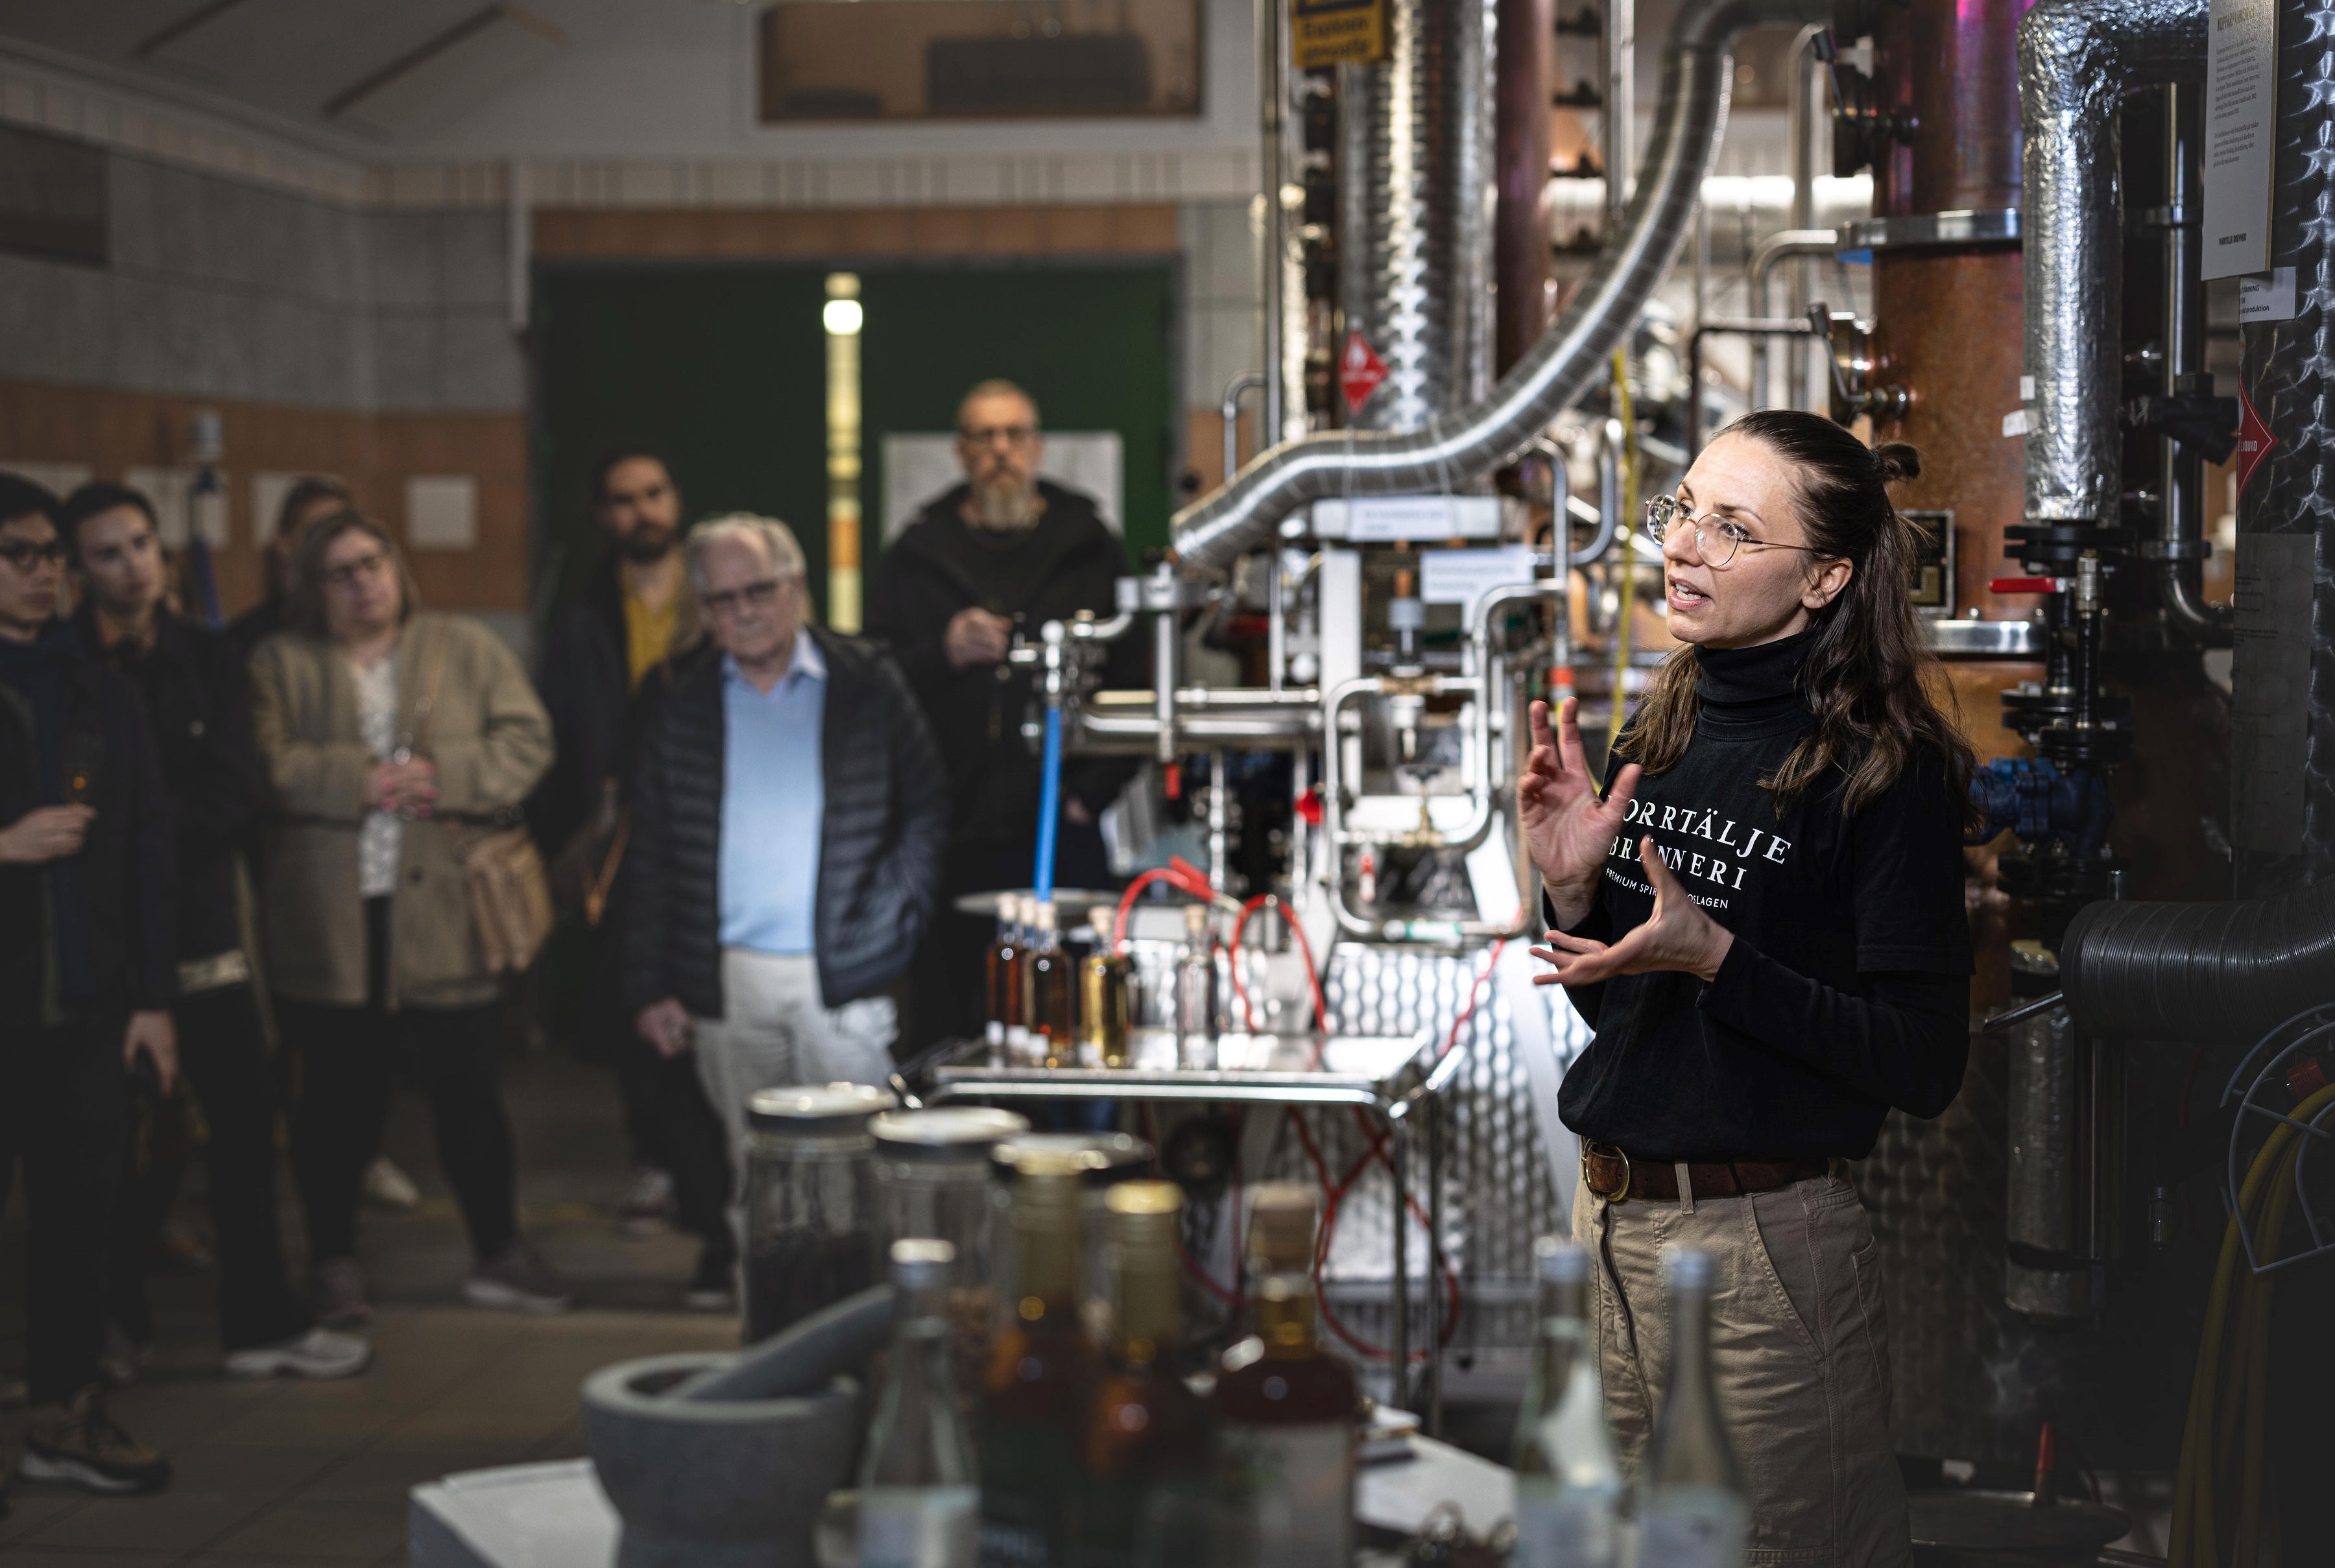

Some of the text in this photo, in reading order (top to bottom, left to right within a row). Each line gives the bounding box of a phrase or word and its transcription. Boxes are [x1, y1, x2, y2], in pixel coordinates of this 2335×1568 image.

[2246, 305, 2269, 315] produktion
[2240, 440, 2257, 452] LIQUID
[1608, 794, 1791, 864] ORRTÄLJE
[1609, 835, 1747, 890] BRNNERI
[1606, 867, 1729, 909] PREMIUM SPIR OSLAGEN
